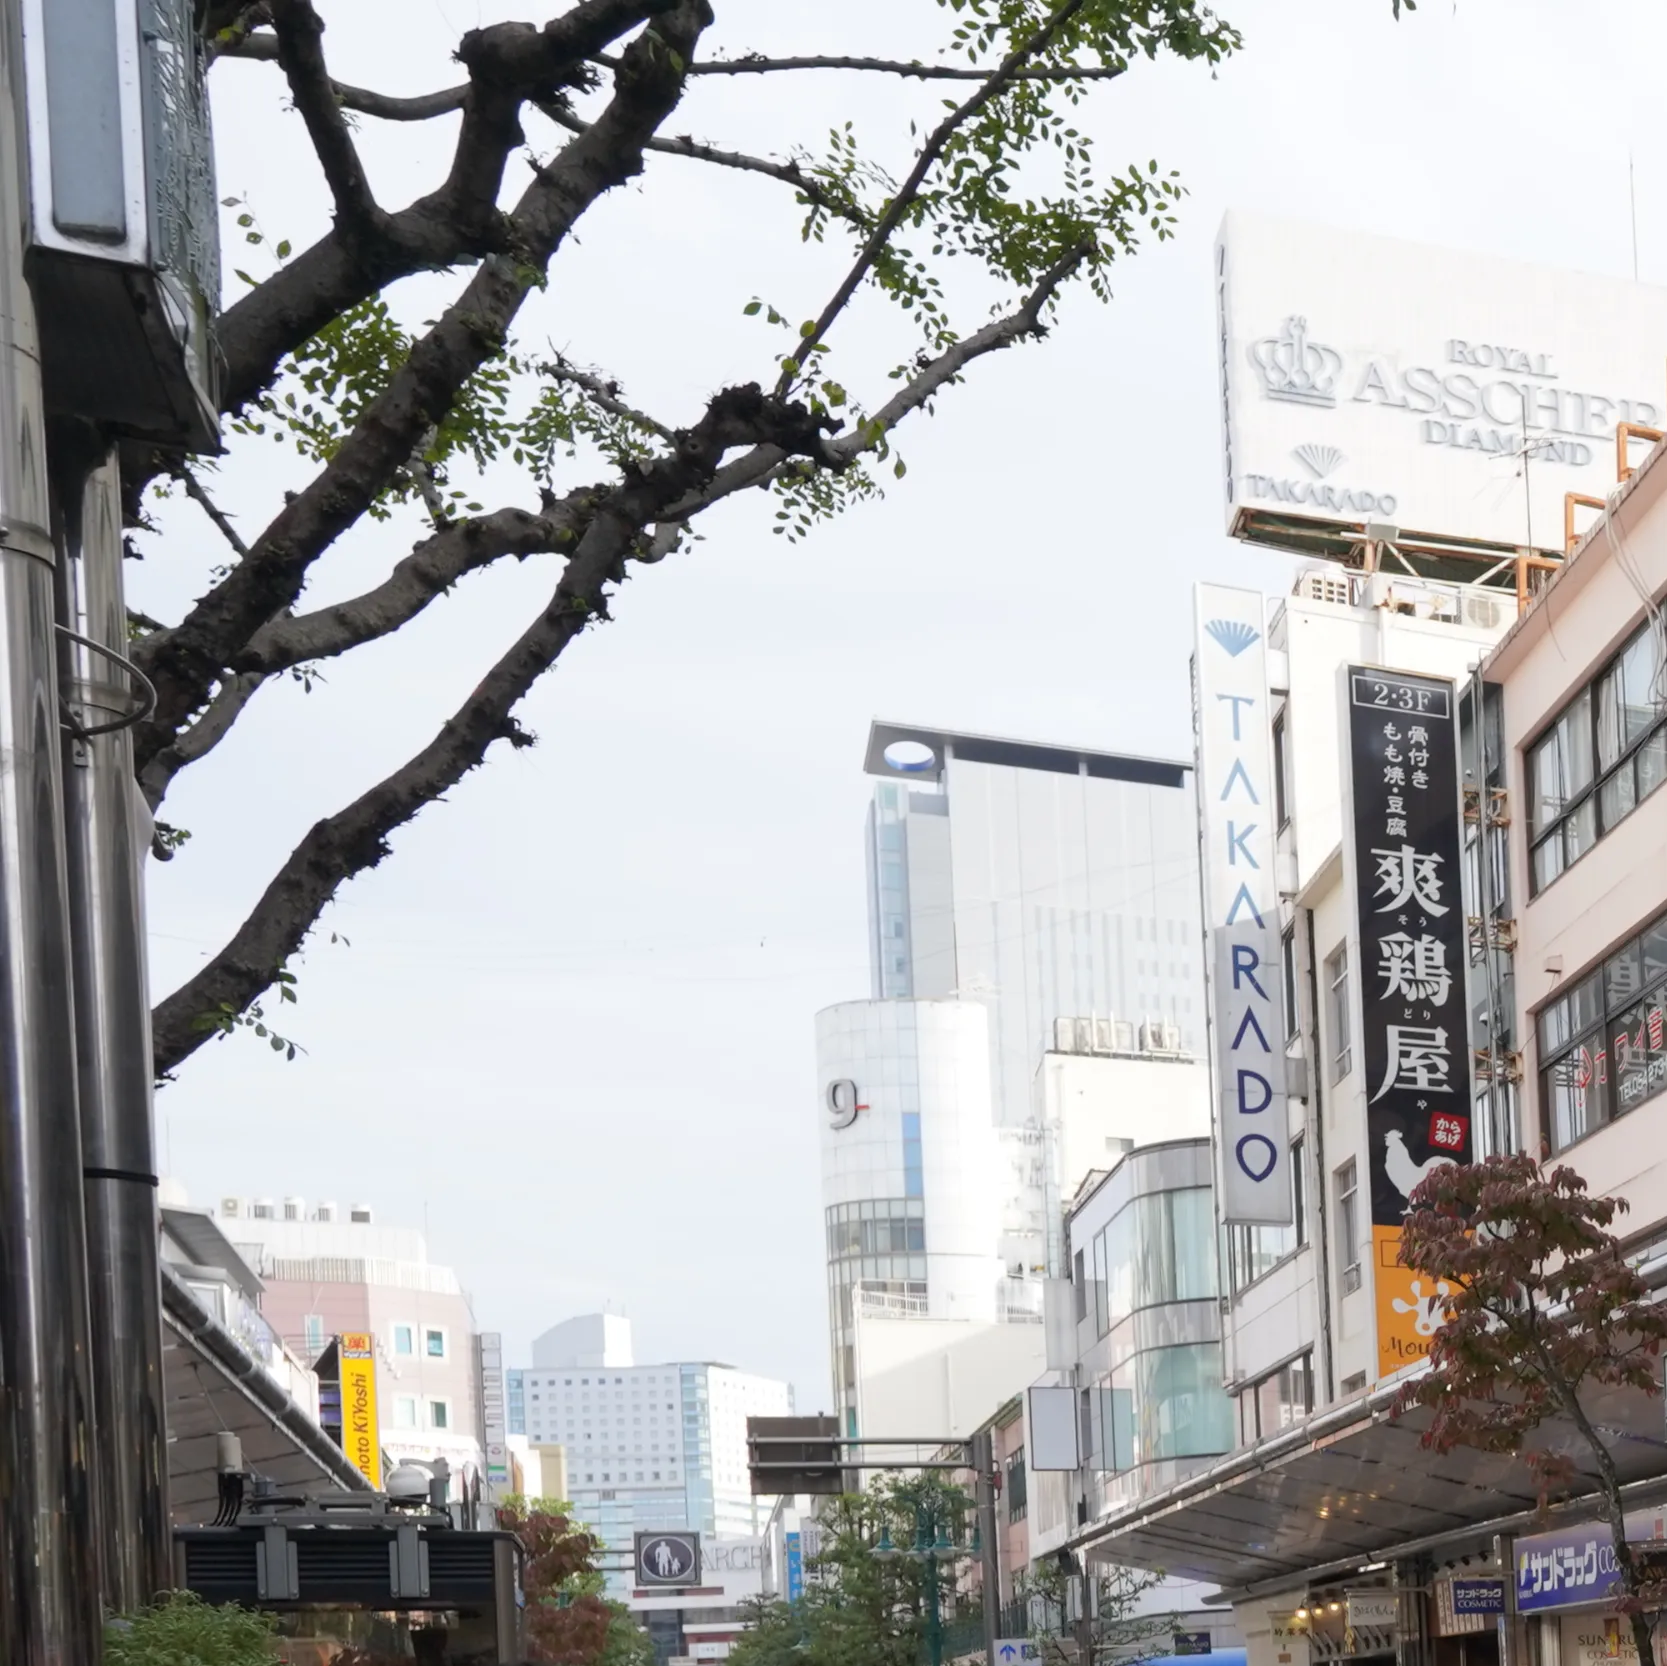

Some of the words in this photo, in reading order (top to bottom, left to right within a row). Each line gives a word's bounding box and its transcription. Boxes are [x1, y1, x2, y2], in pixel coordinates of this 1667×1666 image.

[1447, 338, 1559, 379] ROYAL
[1351, 360, 1659, 445] ASSCHER
[1245, 473, 1398, 516] TAKARADO
[1408, 726, 1430, 789] 骨付き
[1216, 693, 1277, 1183] TAKARADO
[1369, 844, 1454, 1105] 爽鶏屋
[350, 1372, 369, 1434] KiYoshi
[1531, 1540, 1598, 1594] サンドラッグ
[1457, 1599, 1502, 1608] COSMETIC
[1578, 1633, 1638, 1648] SUNRU
